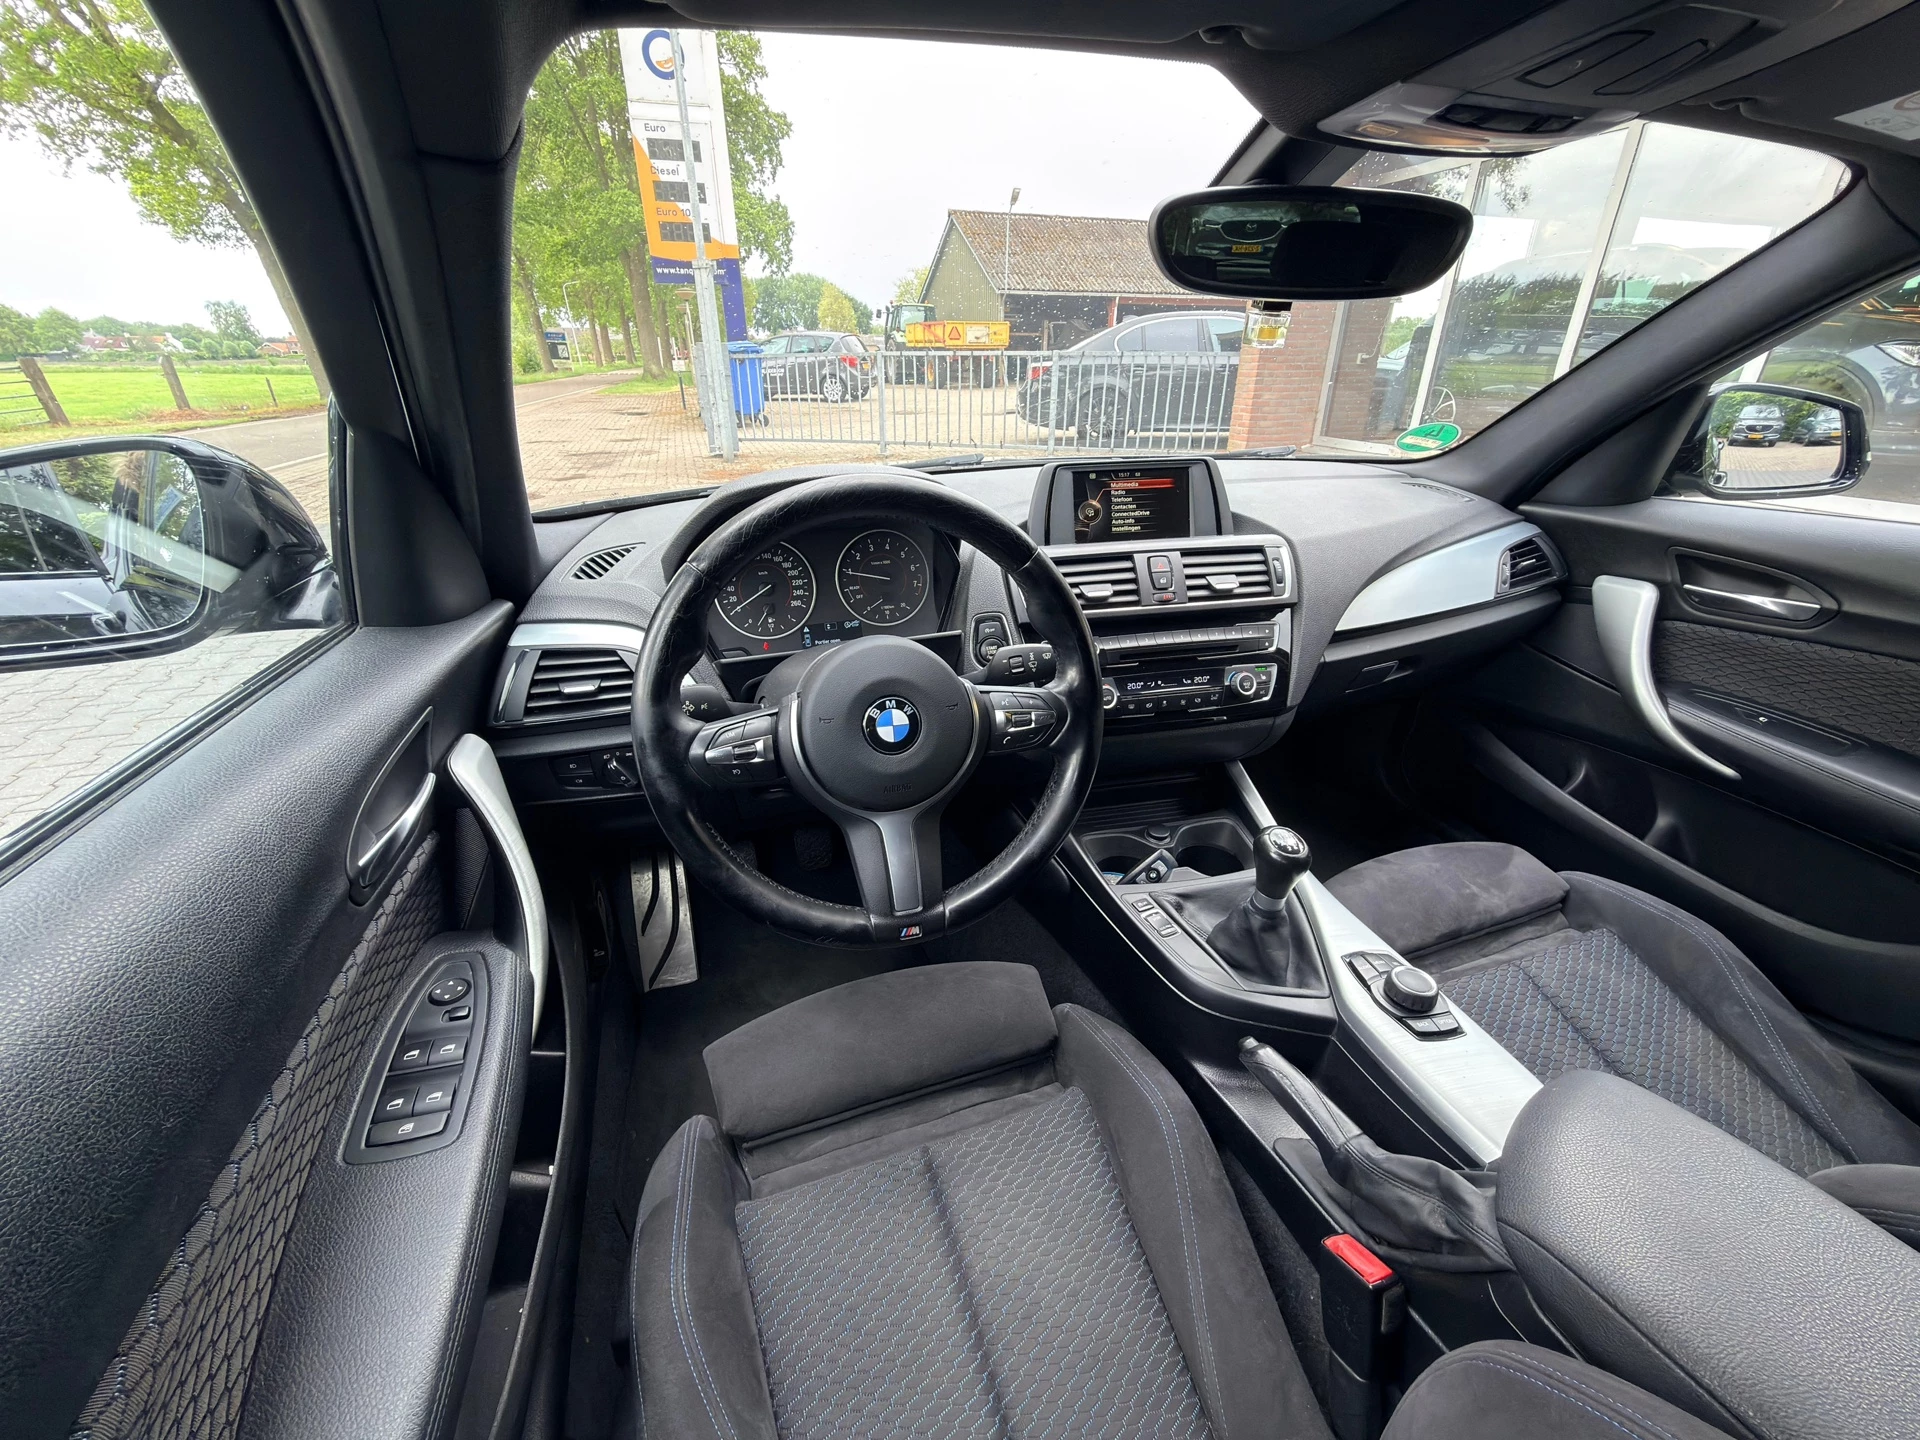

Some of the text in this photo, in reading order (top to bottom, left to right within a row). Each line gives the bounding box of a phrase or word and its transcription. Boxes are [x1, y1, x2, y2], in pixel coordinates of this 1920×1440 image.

[644, 123, 666, 133] Euro
[650, 165, 679, 176] Diesel
[656, 207, 691, 217] Euro 10
[870, 700, 914, 718] BMW
